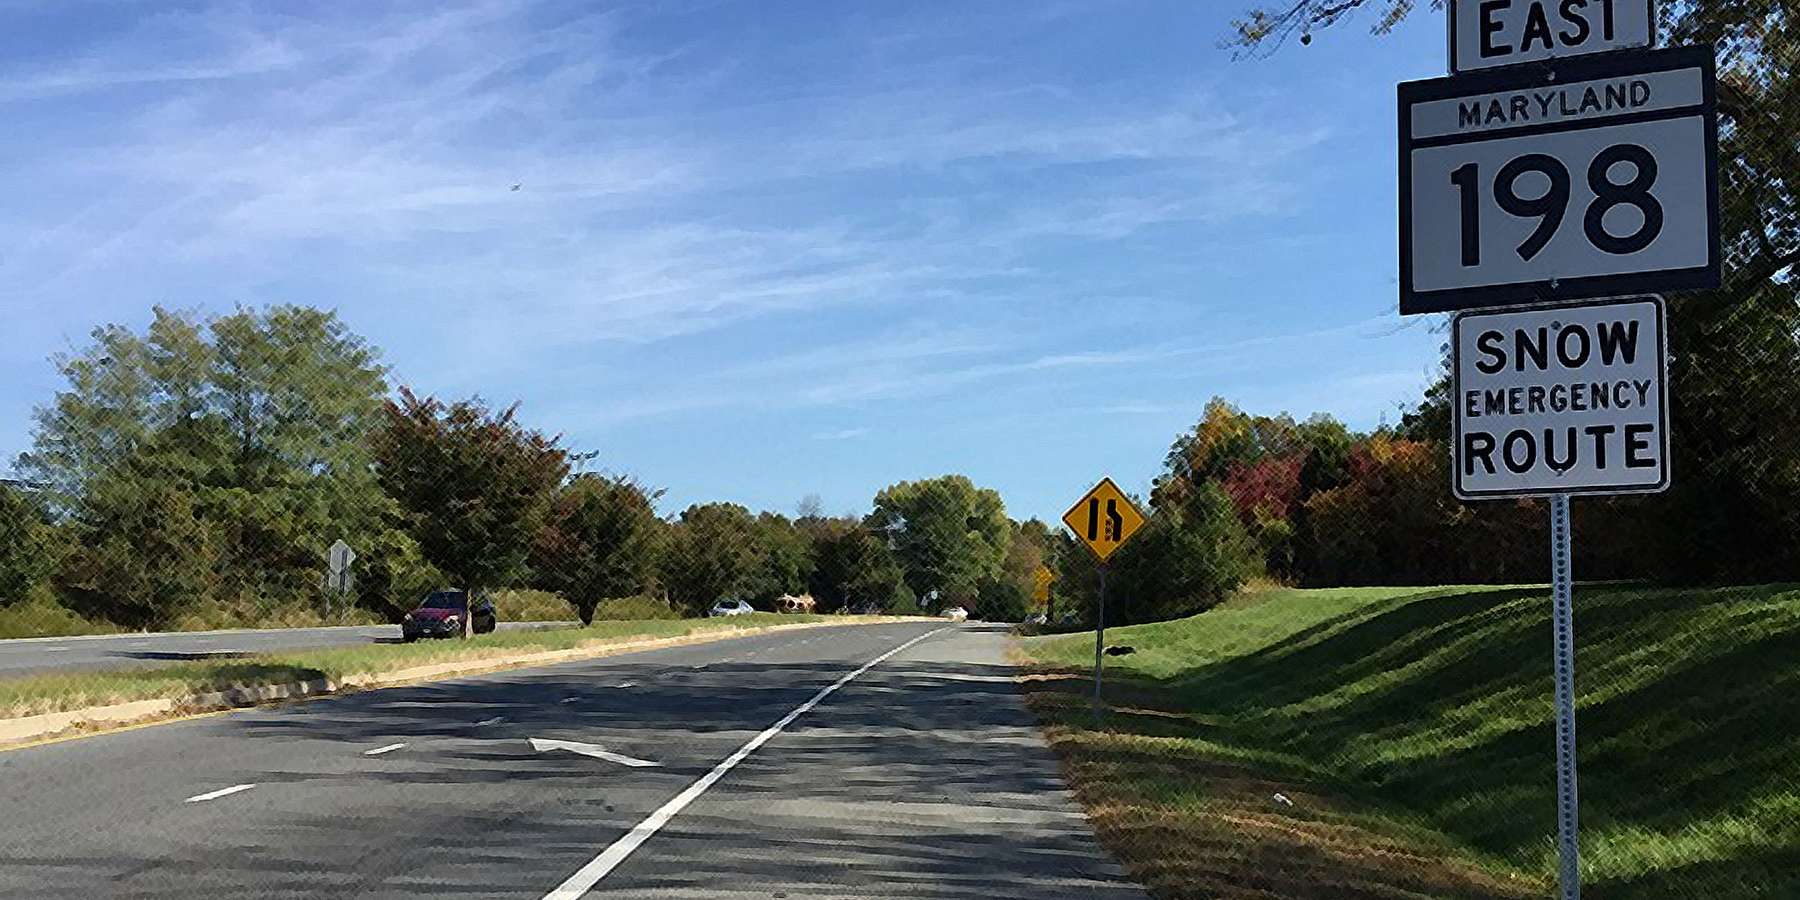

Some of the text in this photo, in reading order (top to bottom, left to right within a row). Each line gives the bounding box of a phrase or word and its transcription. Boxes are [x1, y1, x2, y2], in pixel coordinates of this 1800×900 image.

[1458, 80, 1651, 128] MARYLAND
[1451, 144, 1663, 266] 198
[1475, 320, 1639, 375] SNOW
[1466, 379, 1651, 417] EMERGENCY
[1464, 423, 1657, 476] ROUTE
